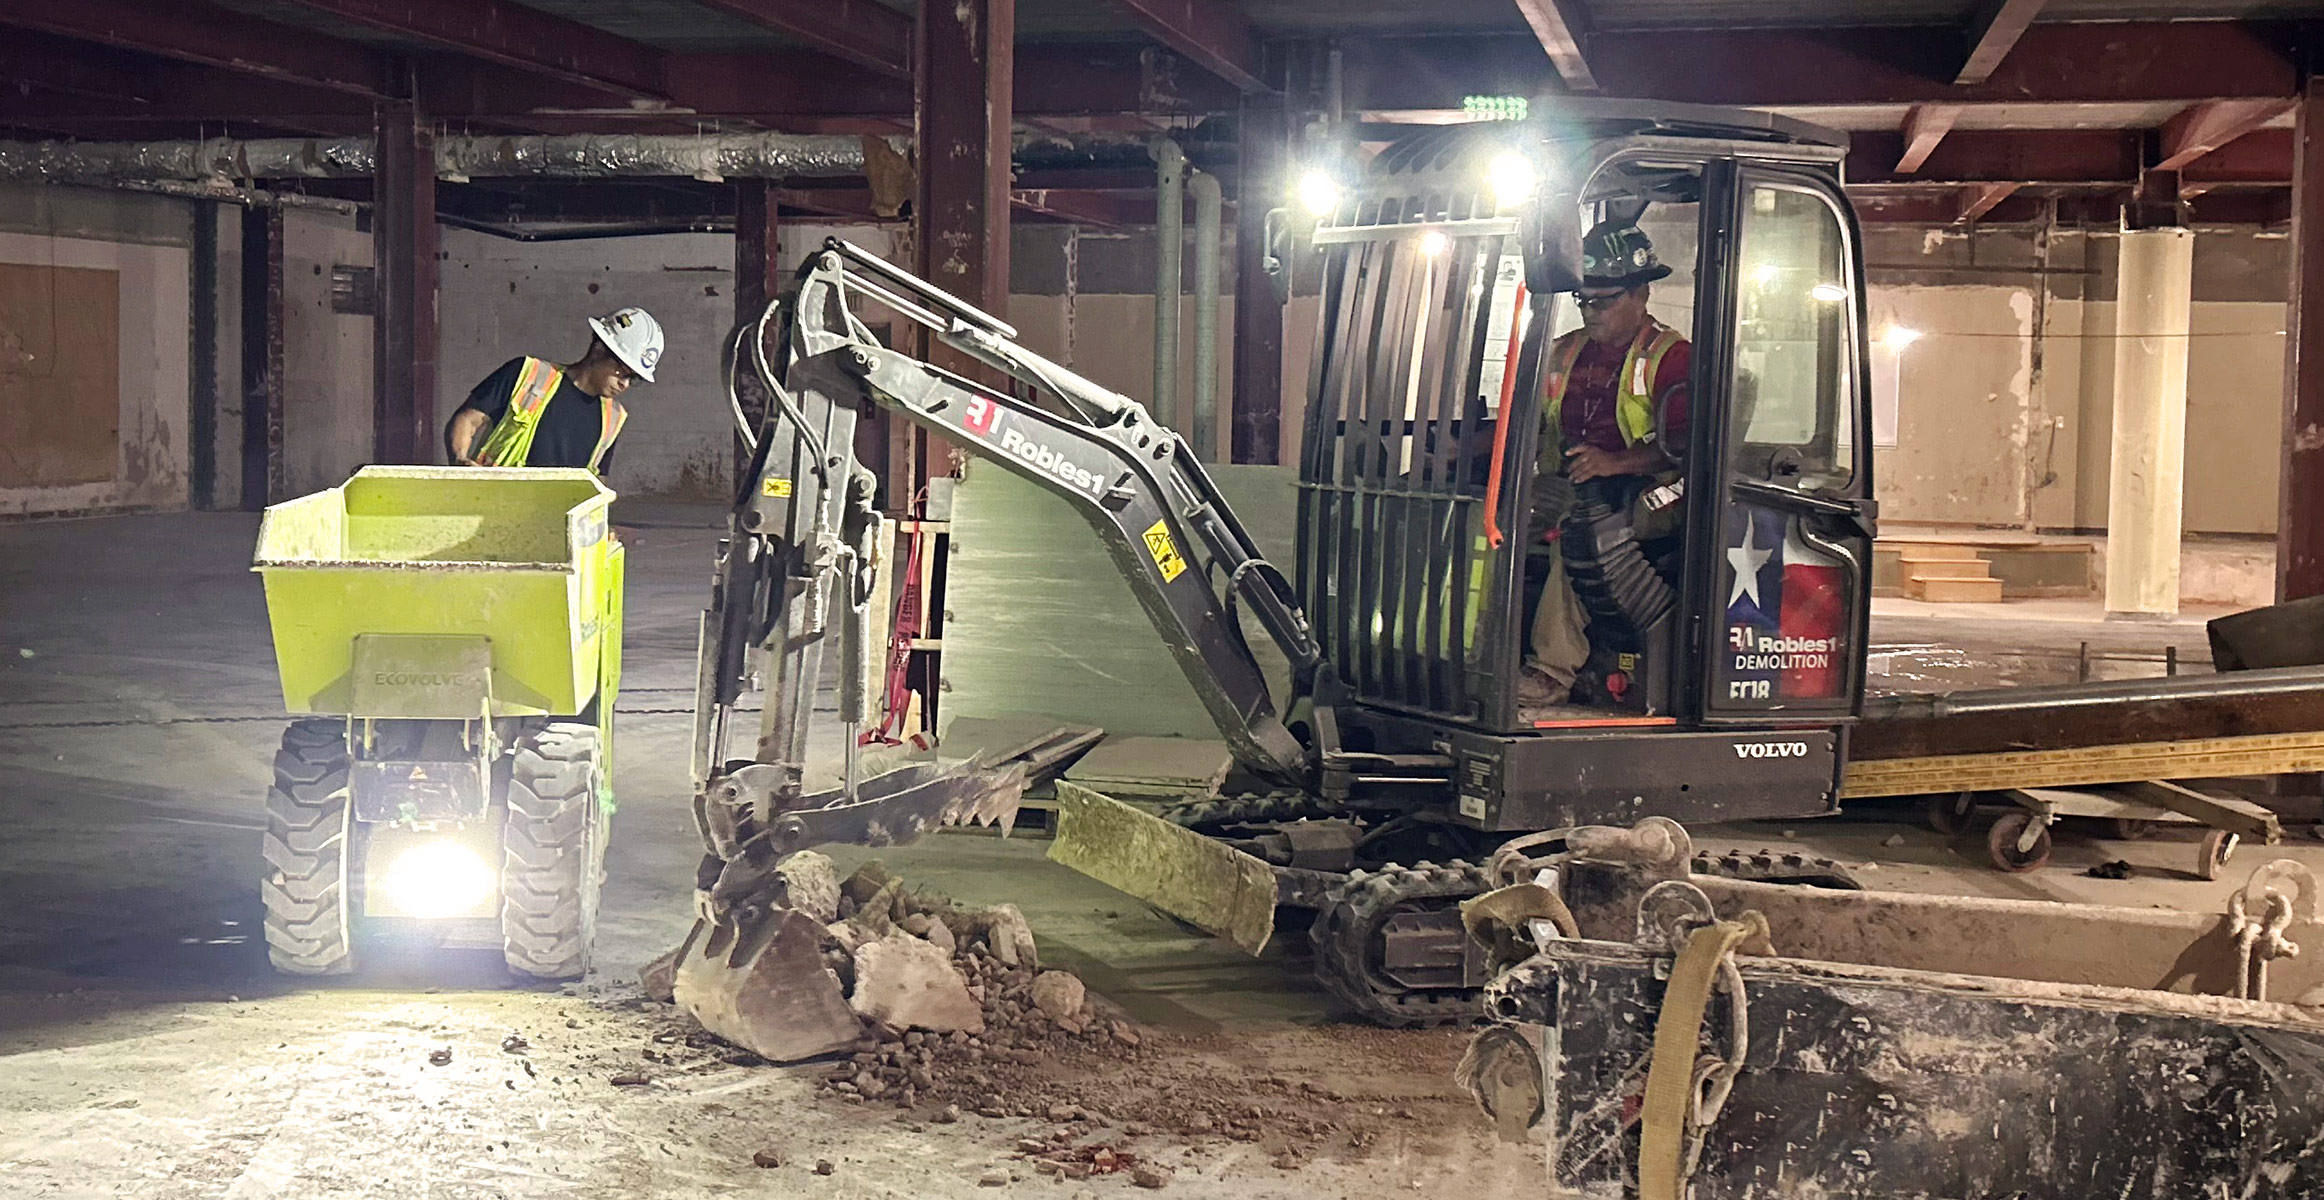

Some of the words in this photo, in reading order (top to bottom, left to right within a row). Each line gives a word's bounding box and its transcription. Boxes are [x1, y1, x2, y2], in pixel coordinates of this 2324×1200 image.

[1001, 427, 1105, 495] Robles1
[1758, 636, 1837, 653] Robles1
[1735, 654, 1829, 670] DEMOLITION
[375, 673, 463, 686] ECOVOLVE
[1733, 742, 1808, 759] VOLVO
